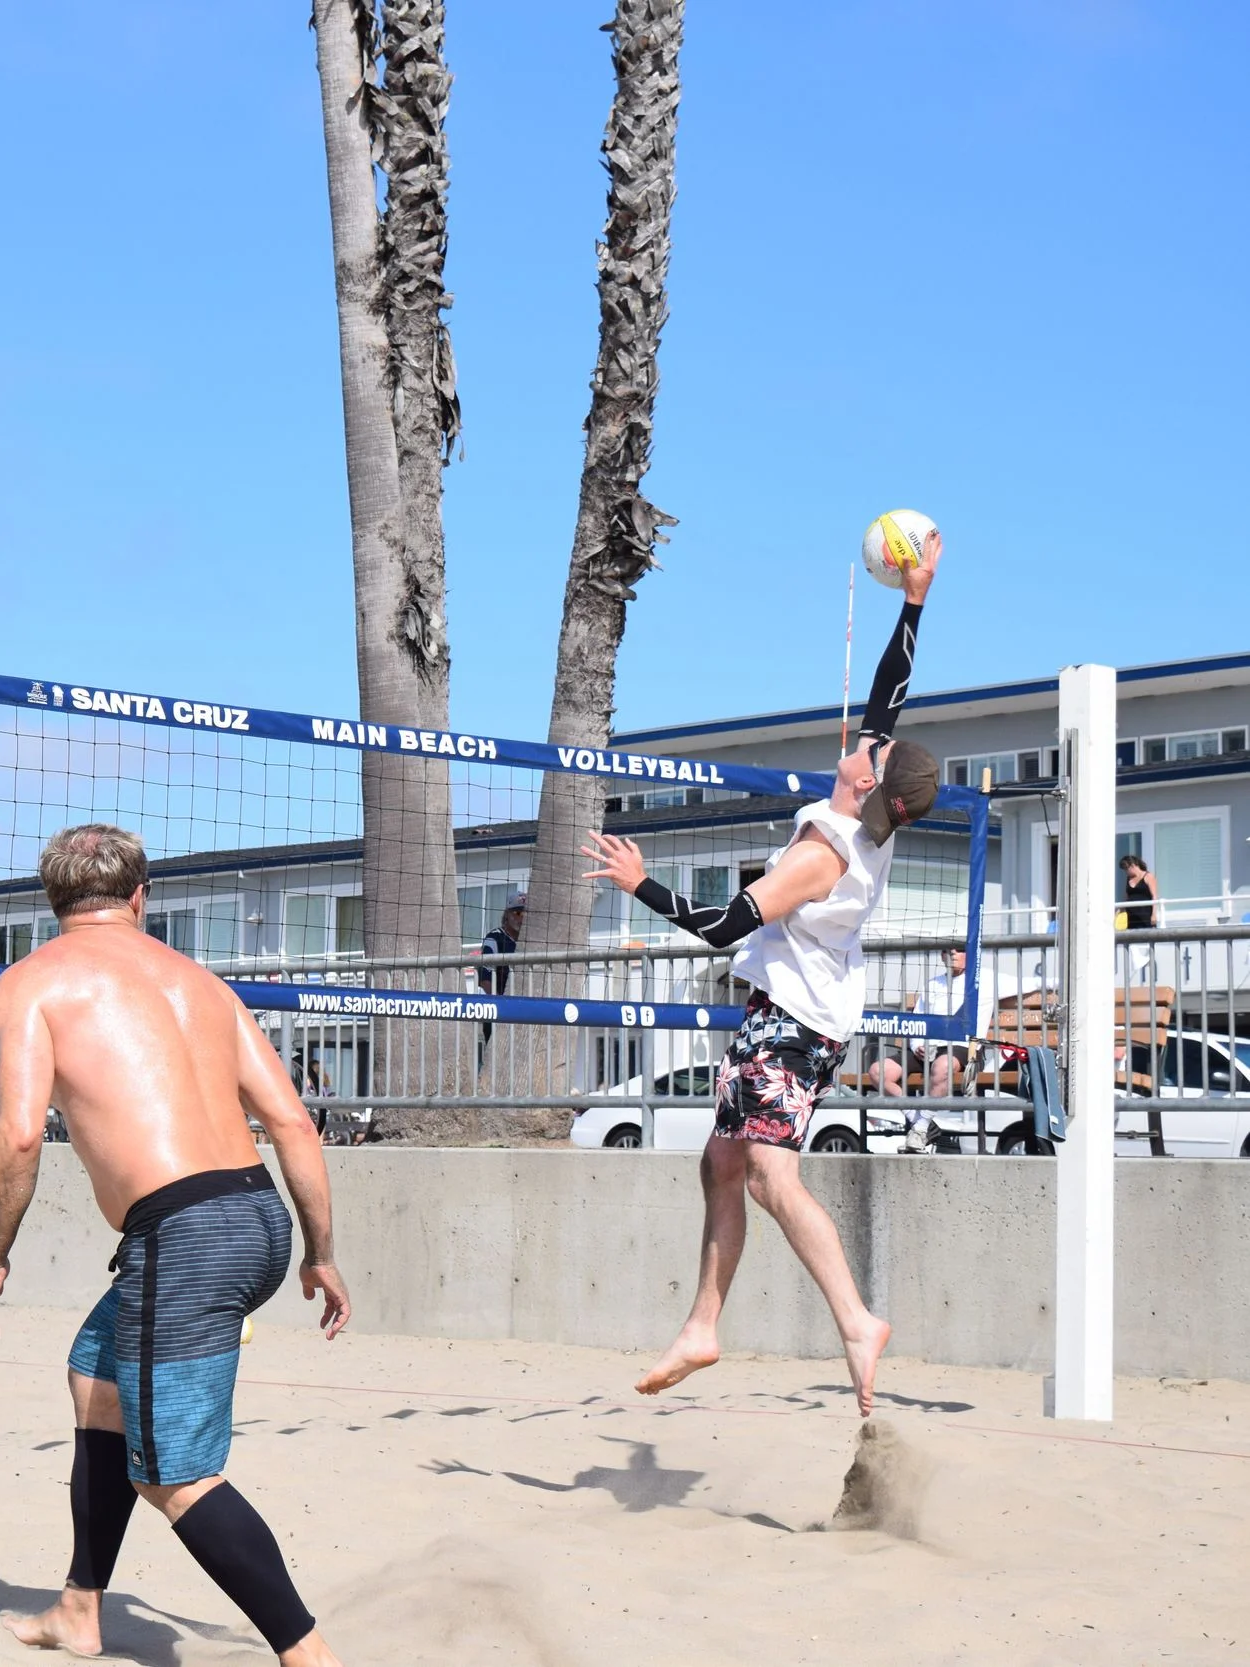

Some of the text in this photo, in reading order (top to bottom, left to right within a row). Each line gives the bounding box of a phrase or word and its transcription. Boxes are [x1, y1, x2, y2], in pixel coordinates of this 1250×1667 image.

[71, 687, 166, 720] SANTA
[173, 701, 250, 731] CRUZ
[312, 718, 387, 747] MAIN
[399, 729, 497, 760] BEACH
[558, 747, 724, 785] VOLLEYBALL
[298, 993, 498, 1020] www.santacruzwharf.com
